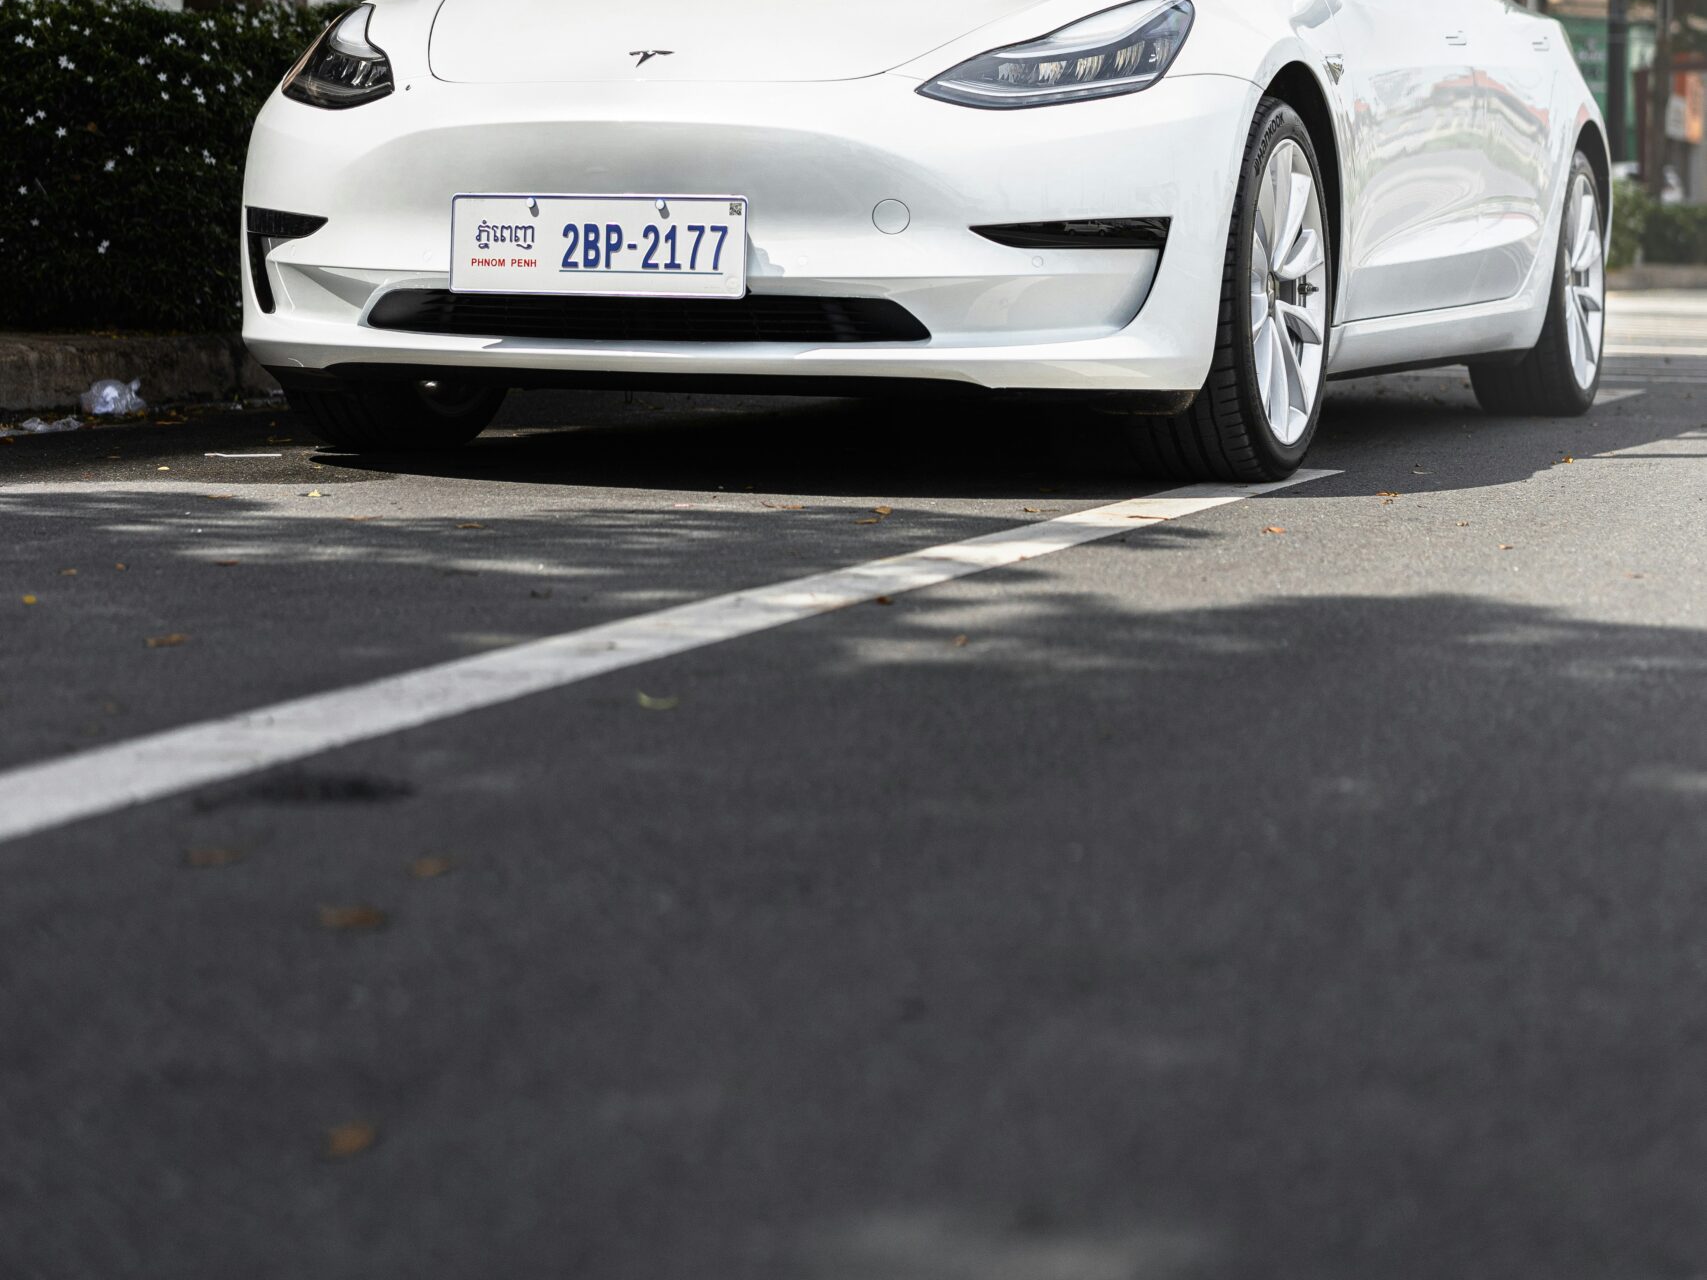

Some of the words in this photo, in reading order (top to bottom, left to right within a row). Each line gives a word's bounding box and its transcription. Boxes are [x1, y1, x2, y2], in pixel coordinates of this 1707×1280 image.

[475, 219, 535, 250] ភ្នំពេញ
[562, 223, 728, 271] 2BP-2177
[471, 258, 506, 267] PHNOM
[511, 258, 537, 268] PENH
